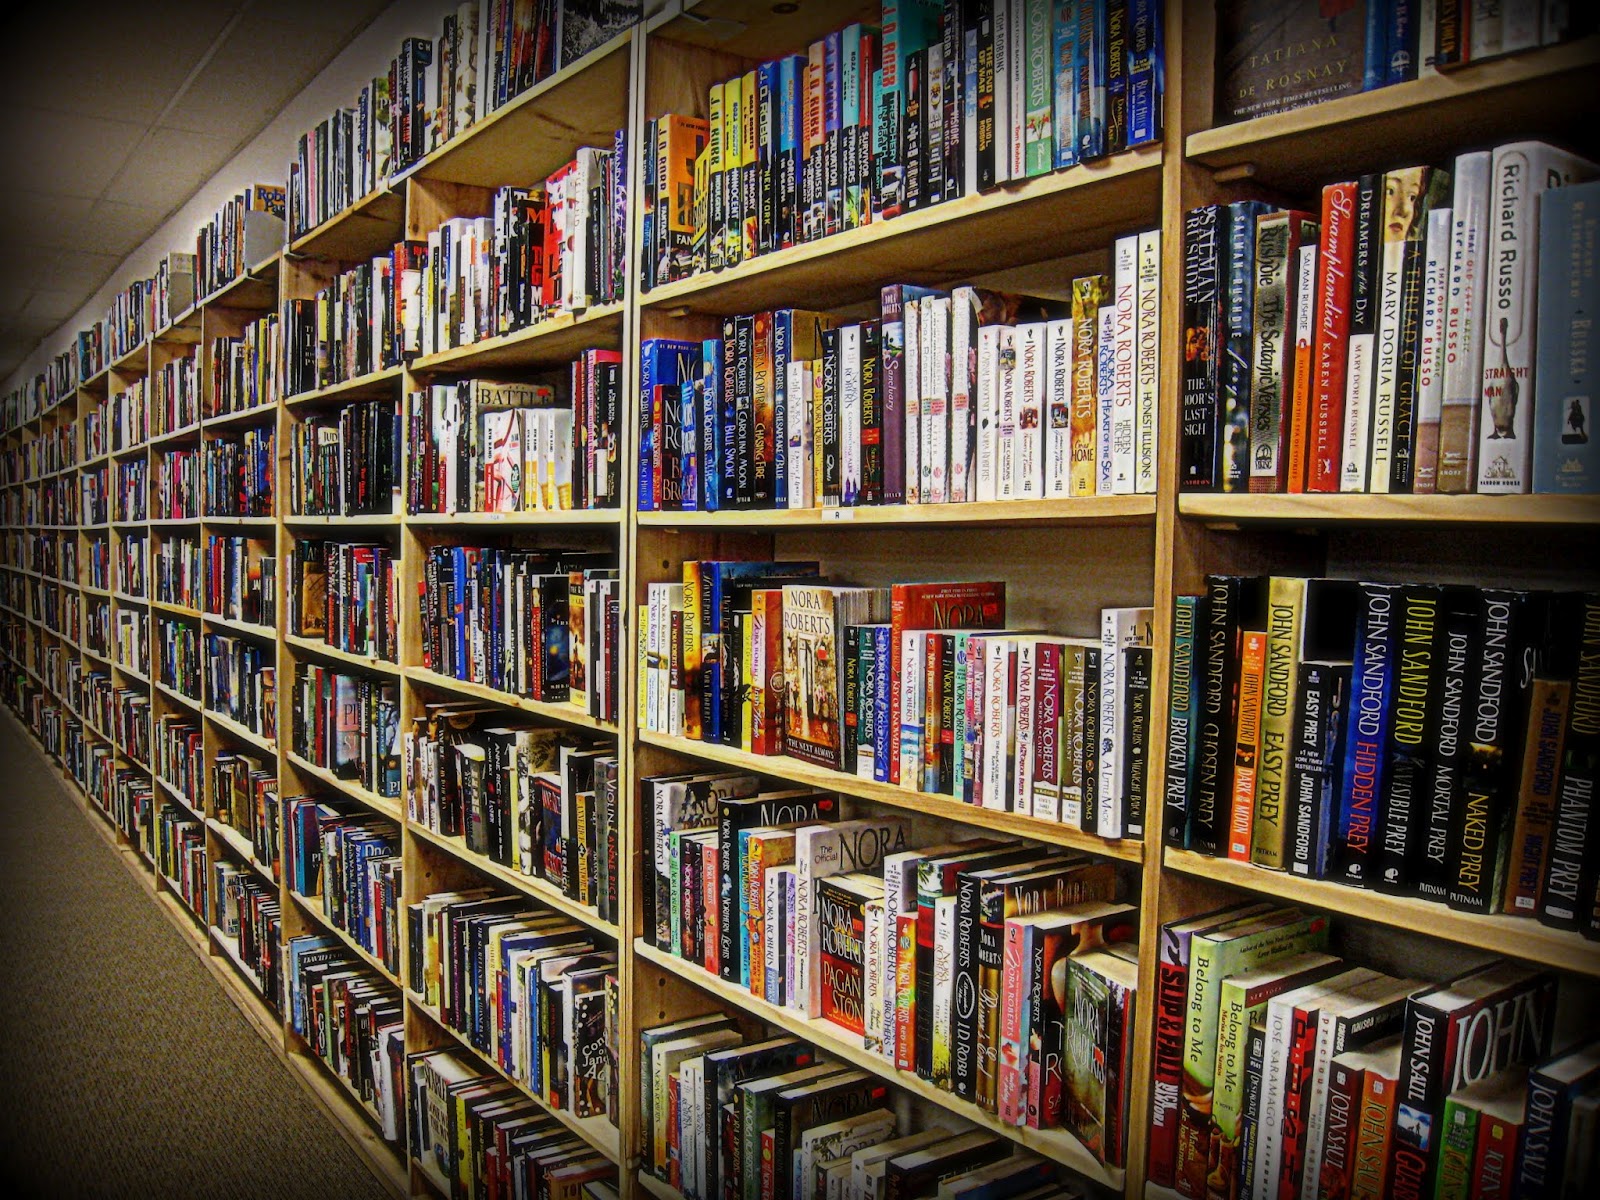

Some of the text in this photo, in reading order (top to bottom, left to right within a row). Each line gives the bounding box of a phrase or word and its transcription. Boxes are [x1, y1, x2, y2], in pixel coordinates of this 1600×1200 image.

[995, 12, 1004, 74] TOM ROBBINS
[1109, 10, 1124, 79] NORA ROBERTS
[1239, 60, 1348, 100] DE ROSNAY
[1249, 36, 1339, 70] TATIANA
[847, 128, 856, 184] STRANGERS
[950, 111, 960, 146] VISIONS
[1198, 209, 1217, 304] SALMAN
[1498, 164, 1520, 311] Richard Russo
[1231, 216, 1244, 339] SALMAN RUSHDIE
[1300, 252, 1311, 330] SALMAN RUSHDIE
[1448, 221, 1464, 364] RICHARD RUSSO
[1115, 284, 1133, 407] NORA ROBERTS
[1140, 289, 1156, 385] NORA ROBERTS
[1256, 226, 1280, 431] Rushdie The Satanic Verses
[1317, 188, 1352, 453] Swamplandia! KAREN RUSSELL
[1422, 260, 1437, 388] RICHARD RUSSO
[823, 356, 834, 445] NORA ROBERTS
[862, 358, 876, 425] NORA ROBERTS
[884, 358, 899, 411] Sanctuary
[1076, 319, 1093, 418] NORA ROBERTS
[1098, 344, 1109, 396] ROBERTS
[1375, 271, 1397, 465] MARY DORIA RUSSELL
[738, 411, 748, 488] CAROLINA MOON
[1114, 422, 1123, 453] RICHES
[1122, 419, 1131, 455] HIDDEN
[1141, 391, 1153, 478] HONEST ILLUSIONS
[683, 581, 695, 653] NORA ROBERTS
[702, 571, 714, 627] HOMEPORT
[783, 614, 831, 635] ROBERTS
[789, 590, 822, 610] NORA
[1404, 595, 1437, 646] JOHN
[991, 660, 1003, 738] NORA ROBERTS
[1042, 684, 1055, 779] NORA ROBERTS
[1085, 682, 1098, 758] NORA ROBERTS
[1102, 652, 1115, 734] NORA ROBERTS
[1166, 603, 1193, 812] JOHN SANDFORD BROKEN PREY
[1197, 581, 1229, 830] JOHN SANDFORD CHOSEN PREY
[1260, 602, 1294, 827] JOHN SANDFORD EASY PREY
[1300, 688, 1320, 748] EASY PREY
[1346, 592, 1392, 856] JOHN SANDFORD HIDDEN PREY
[1394, 648, 1433, 746] SANDFORD
[1232, 672, 1260, 836] JOHN SANDFORD DARK MOON
[1426, 630, 1468, 864] JOHN SANDFORD MORTAL PREY
[1457, 598, 1510, 893] JOHN SANDFORD NAKED PREY
[1085, 777, 1095, 820] GROOMS
[1295, 772, 1314, 861] JOHN SANDFORD
[561, 840, 569, 893] MERRICK
[606, 778, 617, 901] VIOLIN ANNE RICE
[813, 851, 839, 864] Official
[839, 825, 907, 872] NORA
[1383, 820, 1408, 858] PREY
[797, 878, 808, 957] NORA ROBERTS
[822, 896, 854, 935] NORA
[887, 890, 899, 981] NORA ROBERTS
[958, 879, 974, 968] NORA ROBERTS
[823, 961, 862, 1000] PAGAN
[832, 989, 865, 1024] STON
[1032, 947, 1043, 1023] NORA ROBERTS
[1072, 986, 1100, 1044] NORA
[1190, 955, 1210, 1064] Belong to Me
[883, 999, 893, 1045] BROTHERS
[1224, 999, 1243, 1094] Belong to Me
[1315, 1017, 1330, 1096] precious
[1335, 1022, 1347, 1052] nausea
[1407, 1009, 1436, 1102] JOHN SAUL
[1451, 981, 1554, 1096] JOHN
[1152, 1079, 1165, 1128] SANTORA
[1162, 1084, 1179, 1111] NICK
[1266, 1013, 1285, 1128] JOSÉ SARAMAGO
[1188, 1127, 1198, 1162] Marisa
[1323, 1087, 1353, 1171] JOHN SAUL
[1355, 1097, 1387, 1197] JOHN SAUL
[1521, 1078, 1559, 1187] JOHN SAUL
[1481, 1144, 1505, 1193] JOHN
